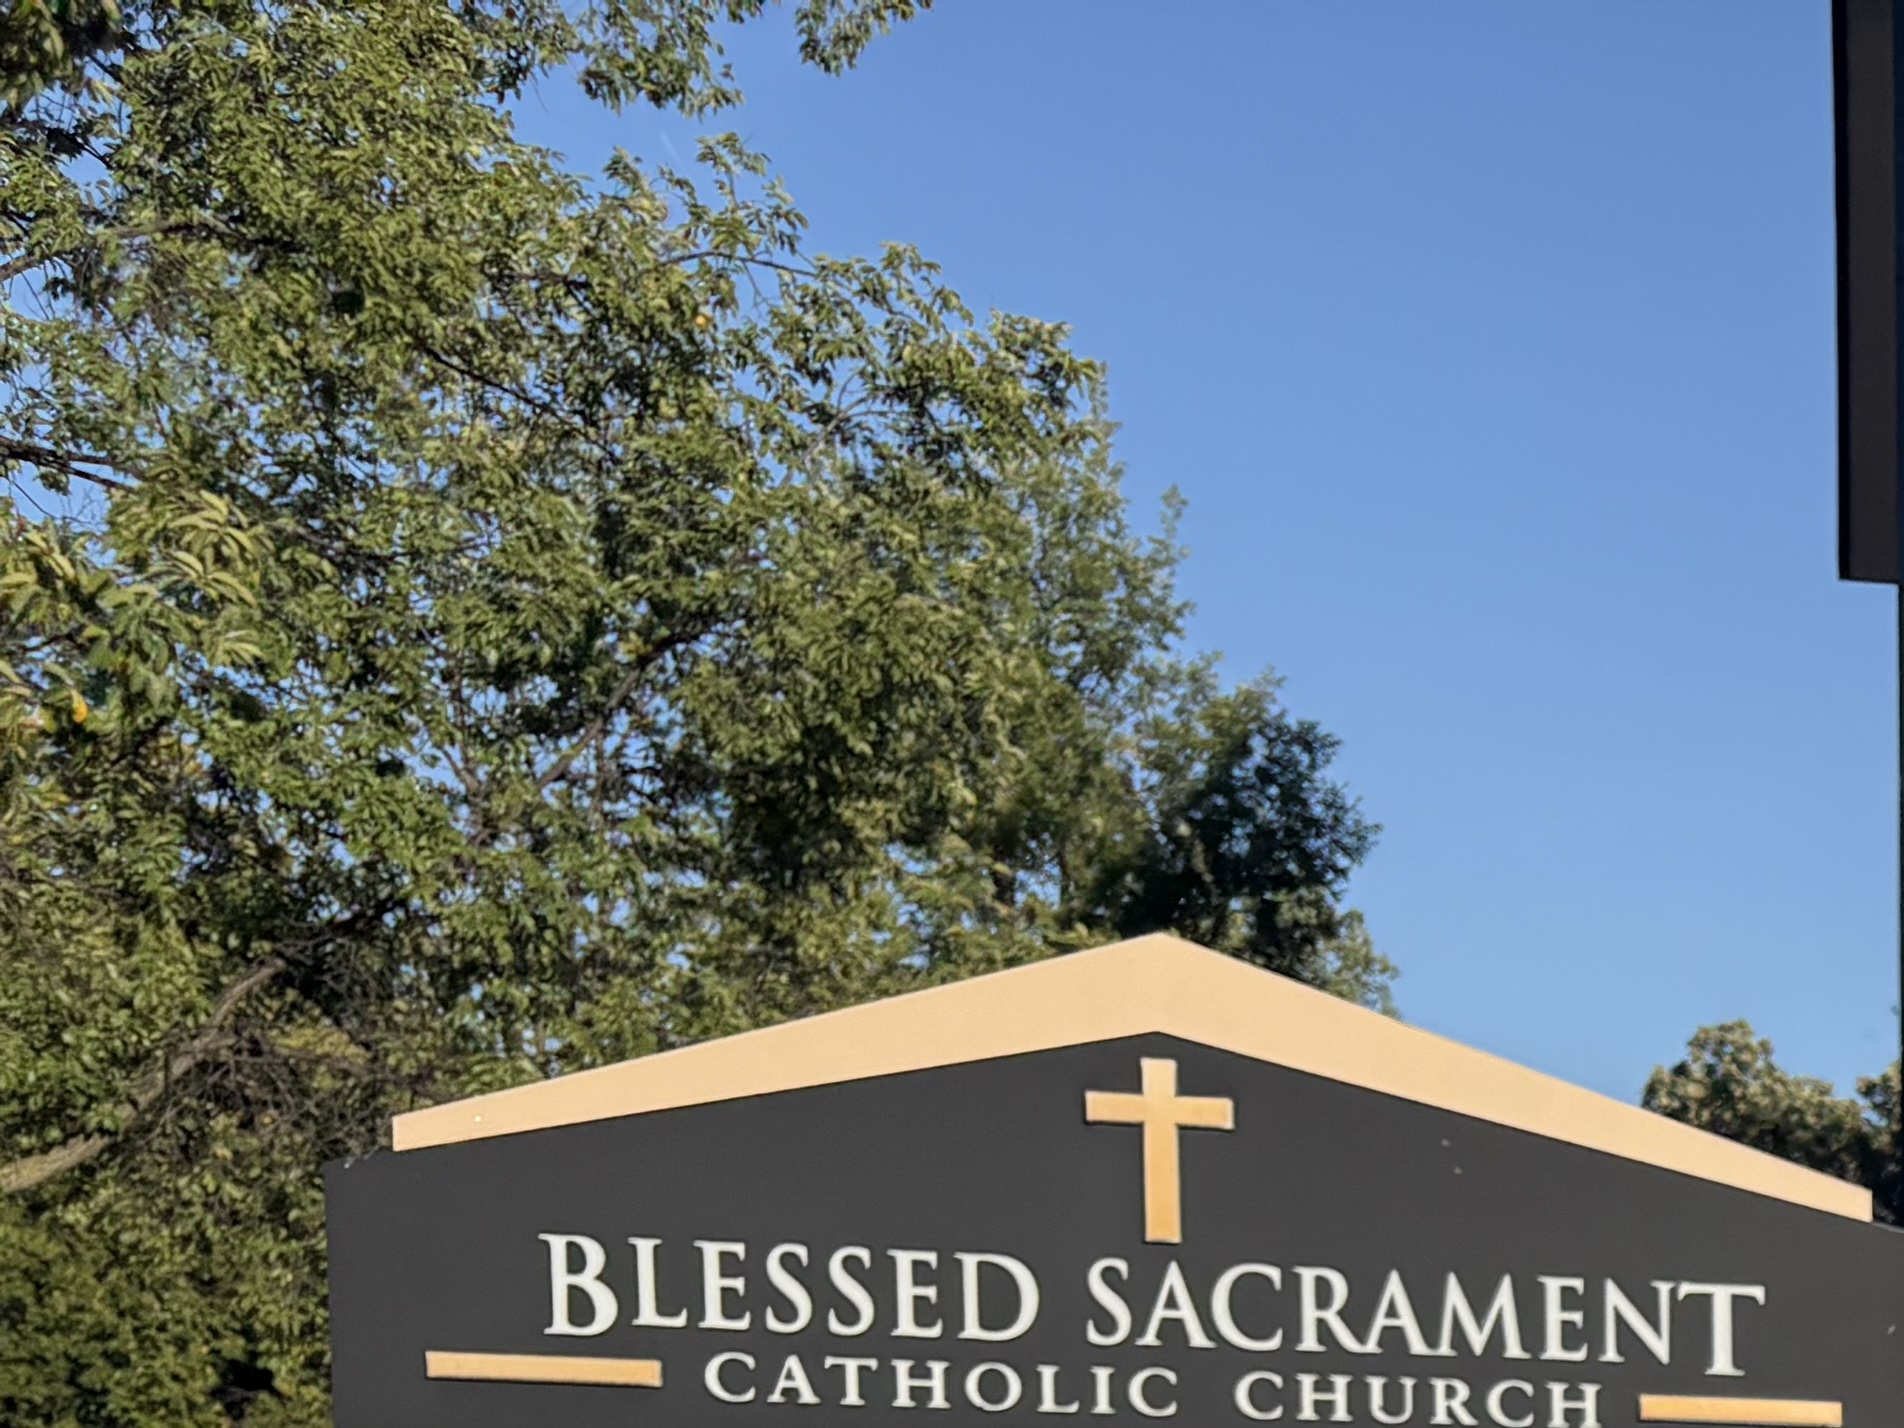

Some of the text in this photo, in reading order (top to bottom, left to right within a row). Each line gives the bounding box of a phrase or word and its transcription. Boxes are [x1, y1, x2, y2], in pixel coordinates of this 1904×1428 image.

[538, 1232, 1766, 1377] BLESSED SACRAMENT
[704, 1351, 1178, 1418] CATHOLIC
